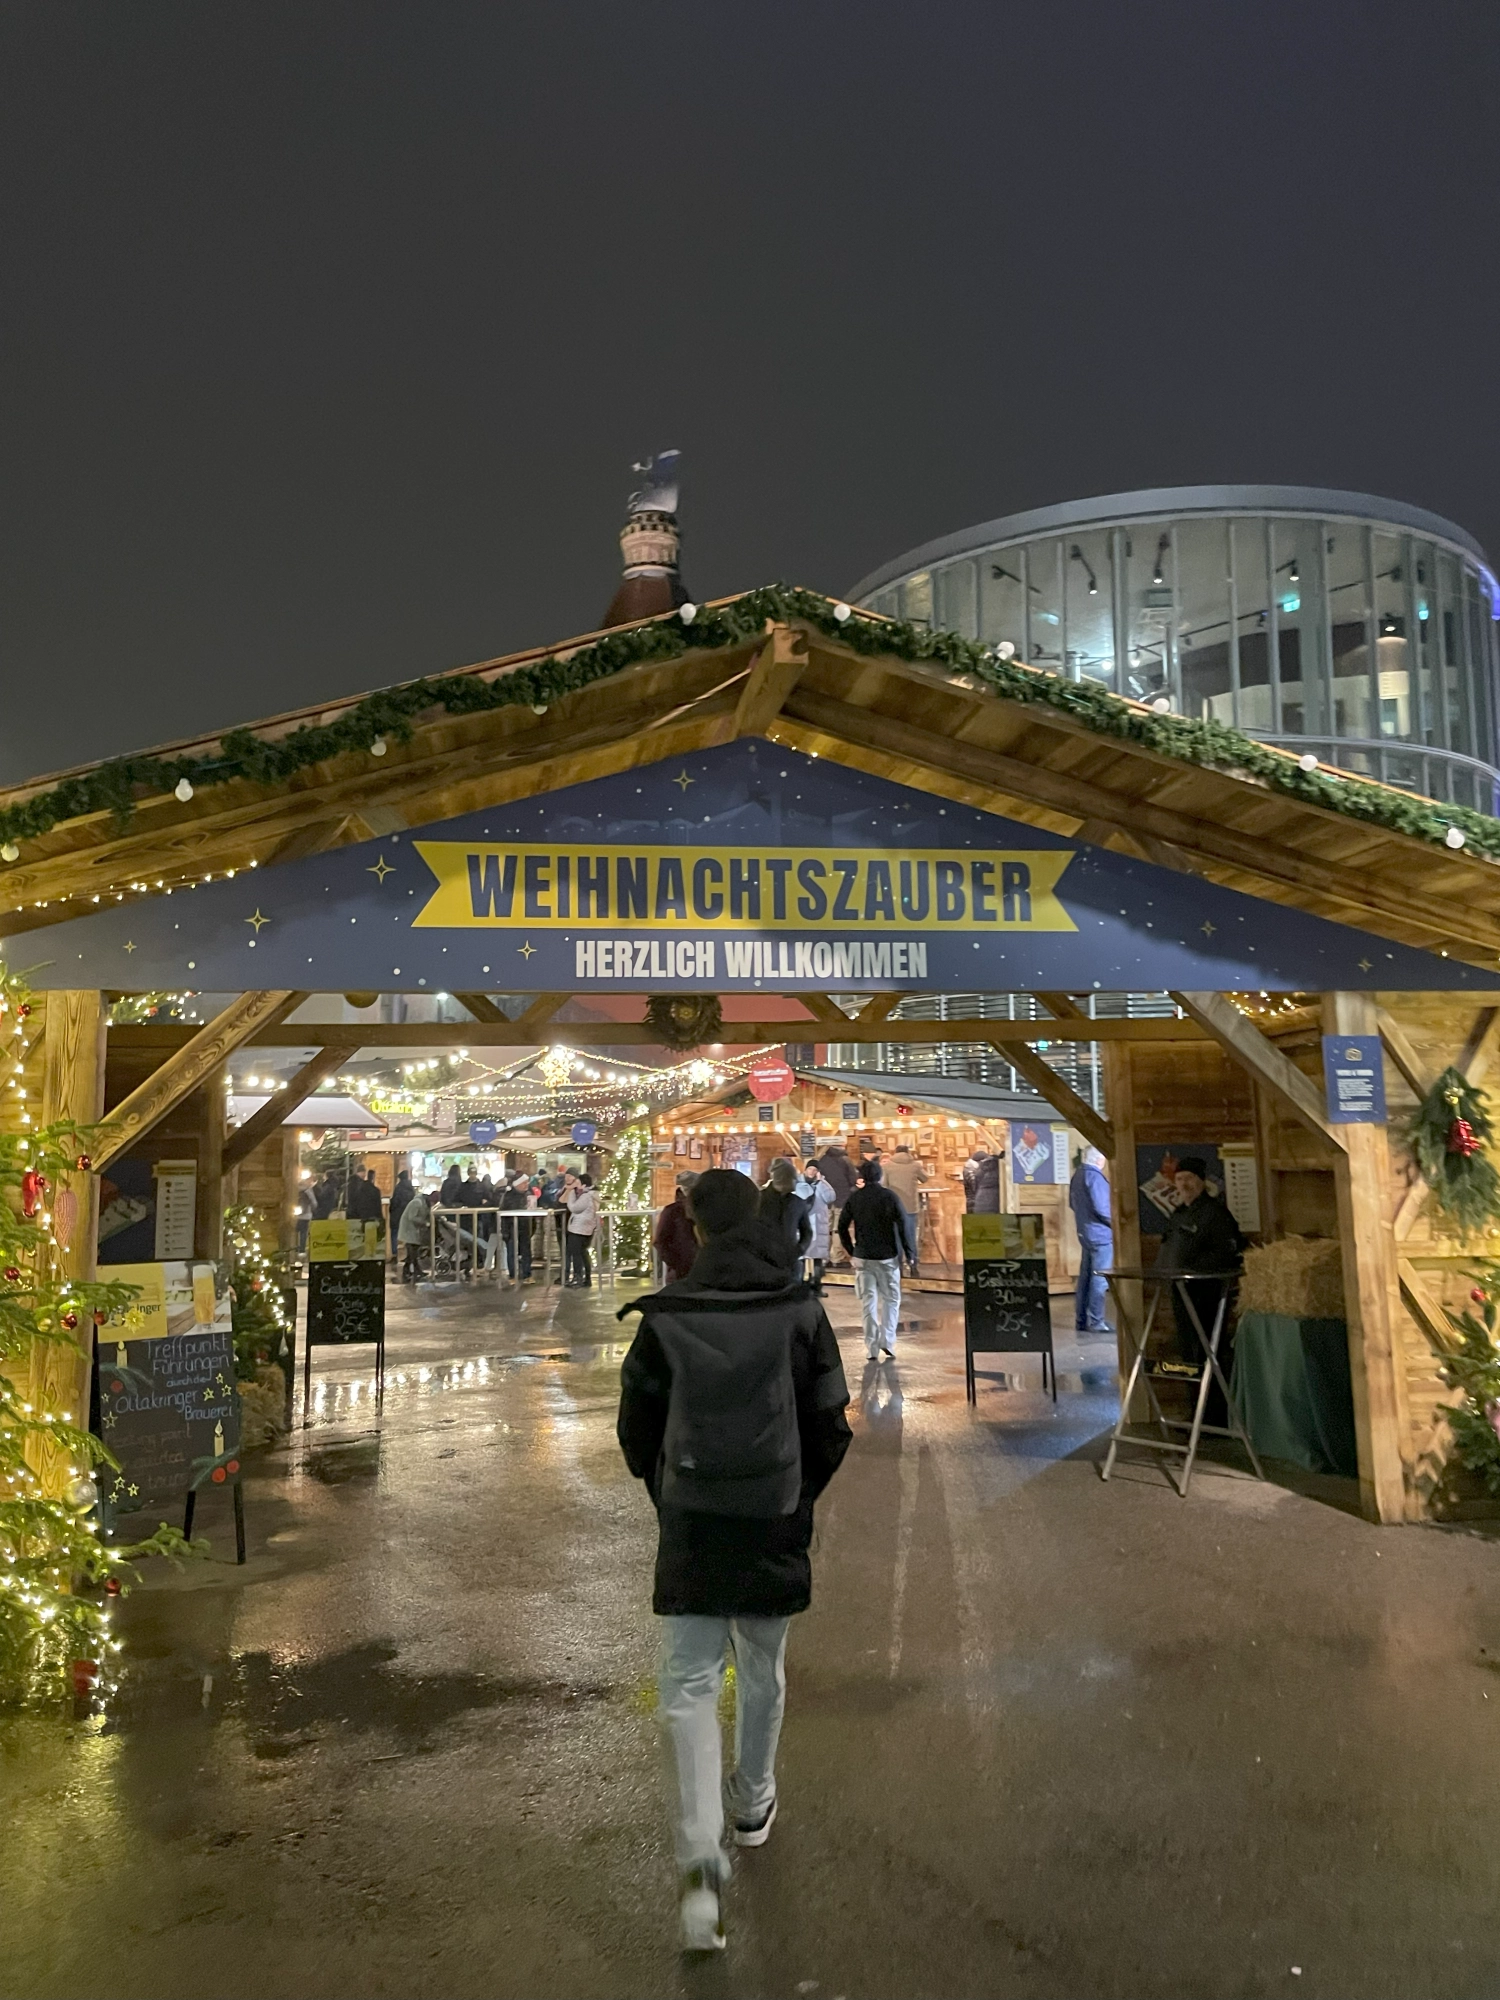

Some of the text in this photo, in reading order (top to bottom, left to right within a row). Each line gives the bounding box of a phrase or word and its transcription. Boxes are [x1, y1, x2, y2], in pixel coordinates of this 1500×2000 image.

[467, 853, 1033, 923] WEIHNACHTSZAUBER
[575, 940, 928, 979] HERZLICH WILLKOMMEN
[333, 1312, 371, 1336] 25€
[144, 1334, 228, 1359] Treffpunkt
[152, 1354, 230, 1379] Führungen
[185, 1403, 233, 1420] Brauerei
